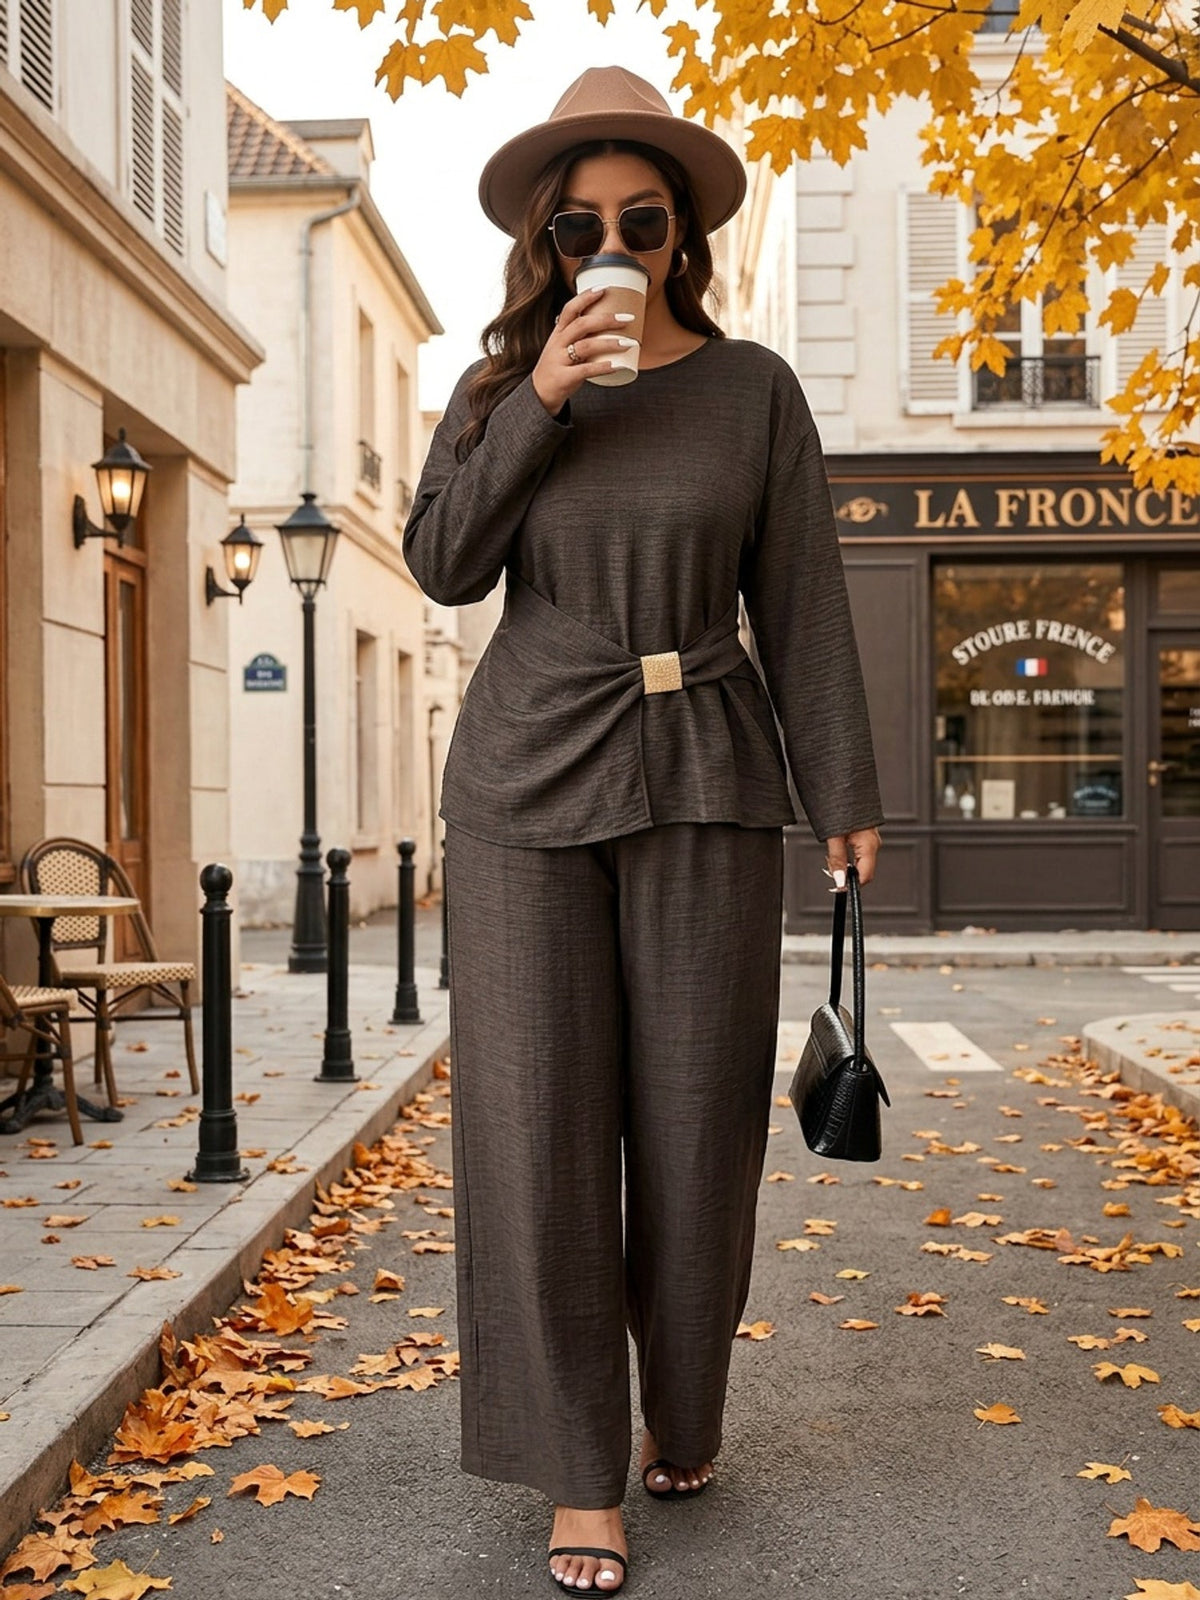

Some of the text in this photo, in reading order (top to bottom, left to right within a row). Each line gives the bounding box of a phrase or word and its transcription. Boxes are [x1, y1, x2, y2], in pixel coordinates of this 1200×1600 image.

[914, 487, 1200, 528] LA FRONCE
[952, 619, 1116, 665] STOURE FRENCE
